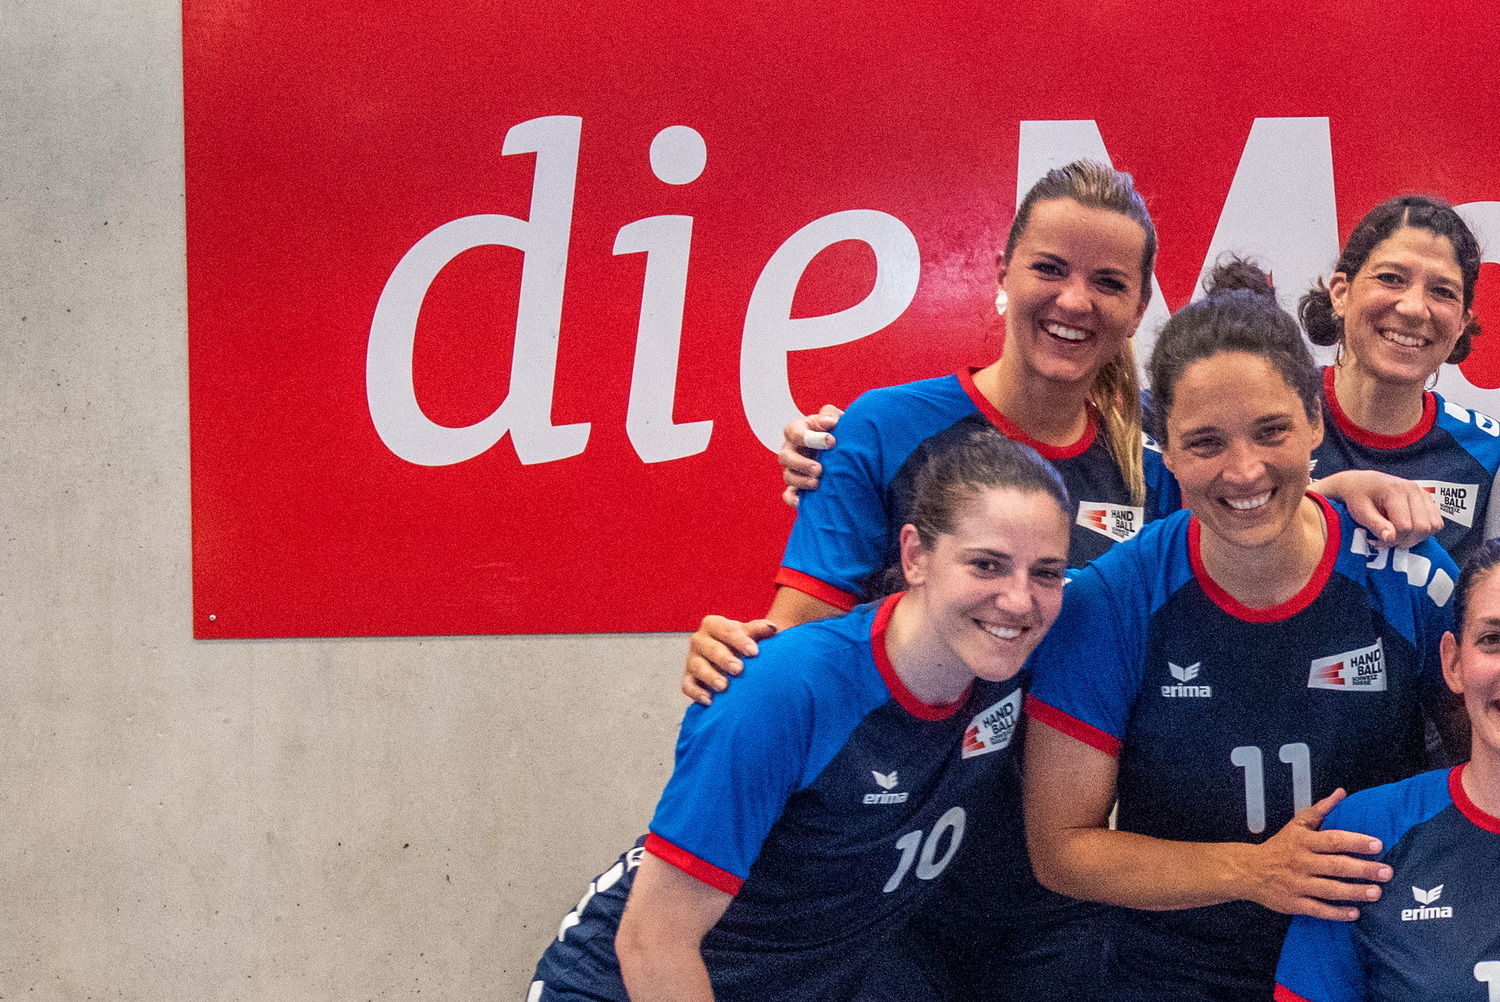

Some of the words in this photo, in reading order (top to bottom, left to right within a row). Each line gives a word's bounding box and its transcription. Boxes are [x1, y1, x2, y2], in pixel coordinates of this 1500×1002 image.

[366, 114, 920, 467] die
[1440, 487, 1467, 499] HAND
[1445, 497, 1467, 510] BALL
[1111, 510, 1134, 522] HAND
[1116, 519, 1135, 533] BALL
[1351, 648, 1381, 668] HAND
[1358, 661, 1382, 676] BALL
[1161, 682, 1212, 698] erima
[983, 702, 1013, 728] HAND
[992, 714, 1014, 734] BALL
[1230, 742, 1312, 834] 11
[863, 790, 909, 805] erima
[882, 806, 967, 892] 10
[1401, 904, 1453, 921] erima
